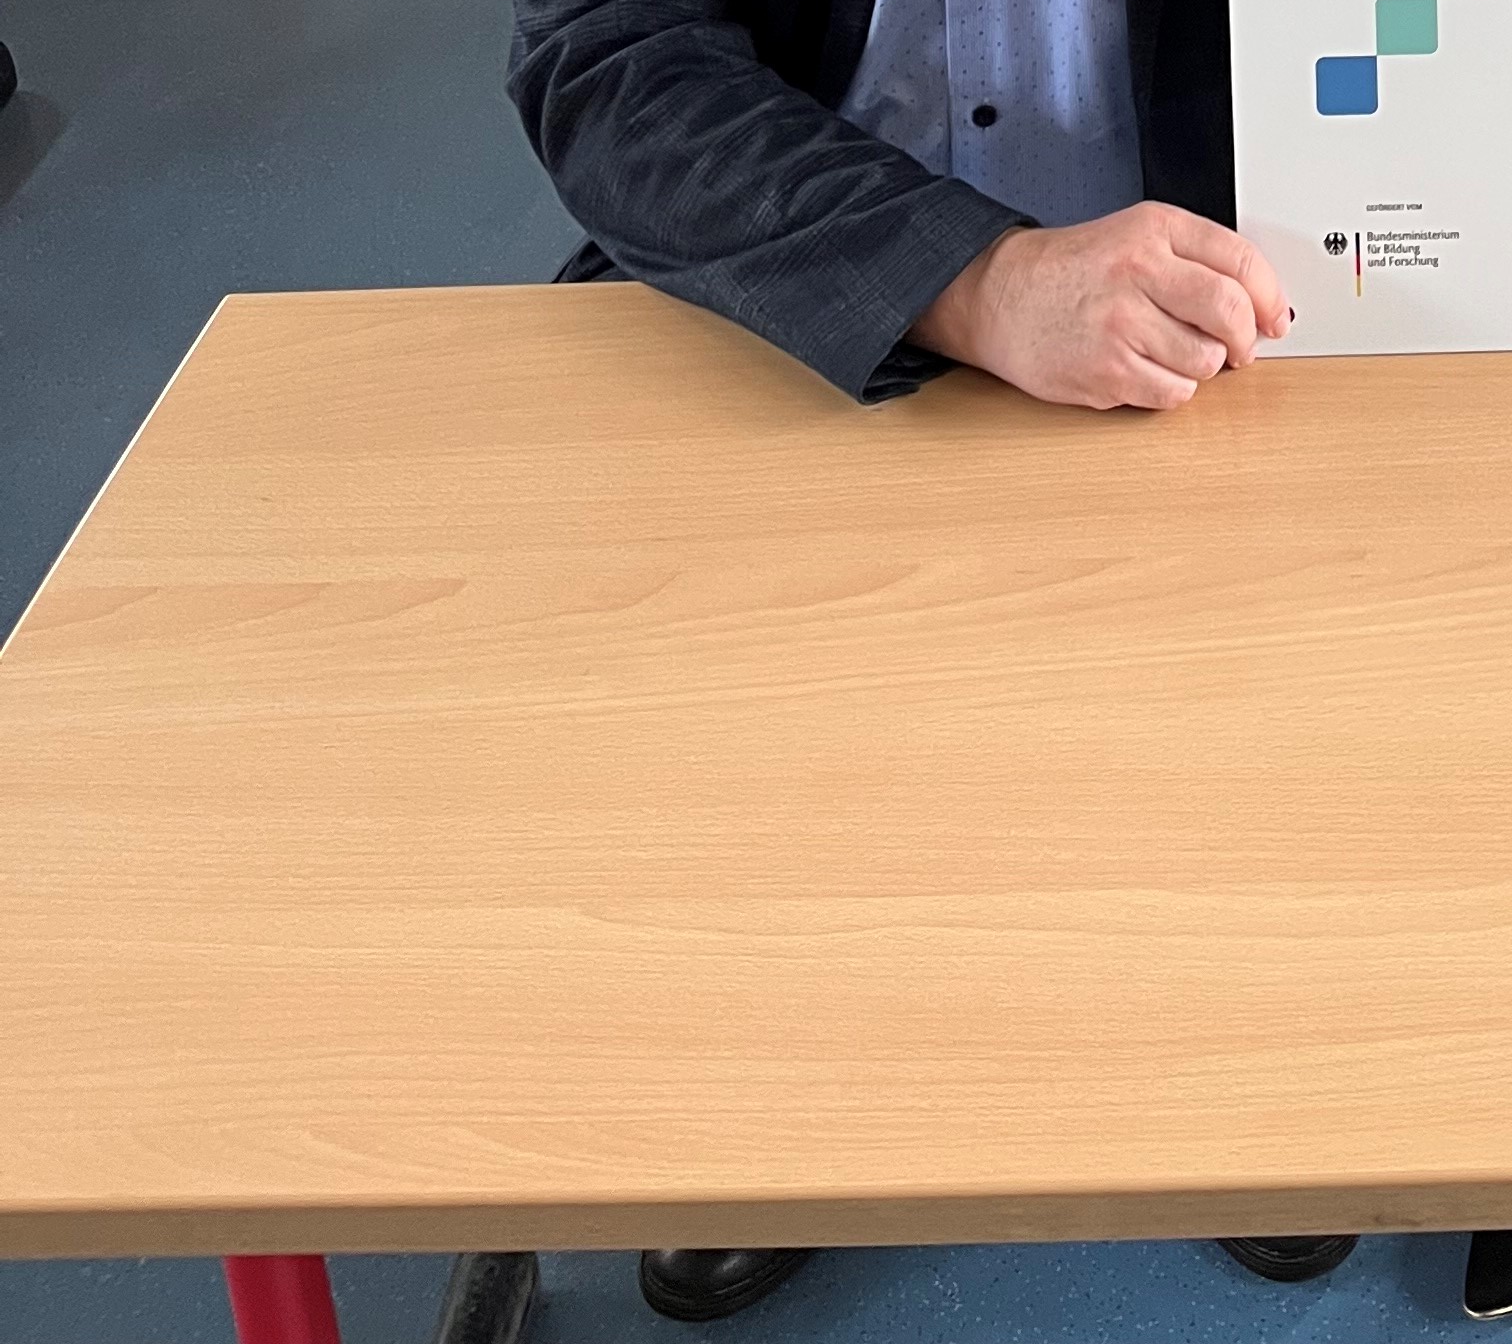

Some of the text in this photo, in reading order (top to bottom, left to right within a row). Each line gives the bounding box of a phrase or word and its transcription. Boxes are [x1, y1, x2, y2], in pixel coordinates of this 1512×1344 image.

[1367, 230, 1460, 242] Bundesministerium
[1368, 244, 1420, 256] für Bildung
[1368, 255, 1439, 268] und Forschung
